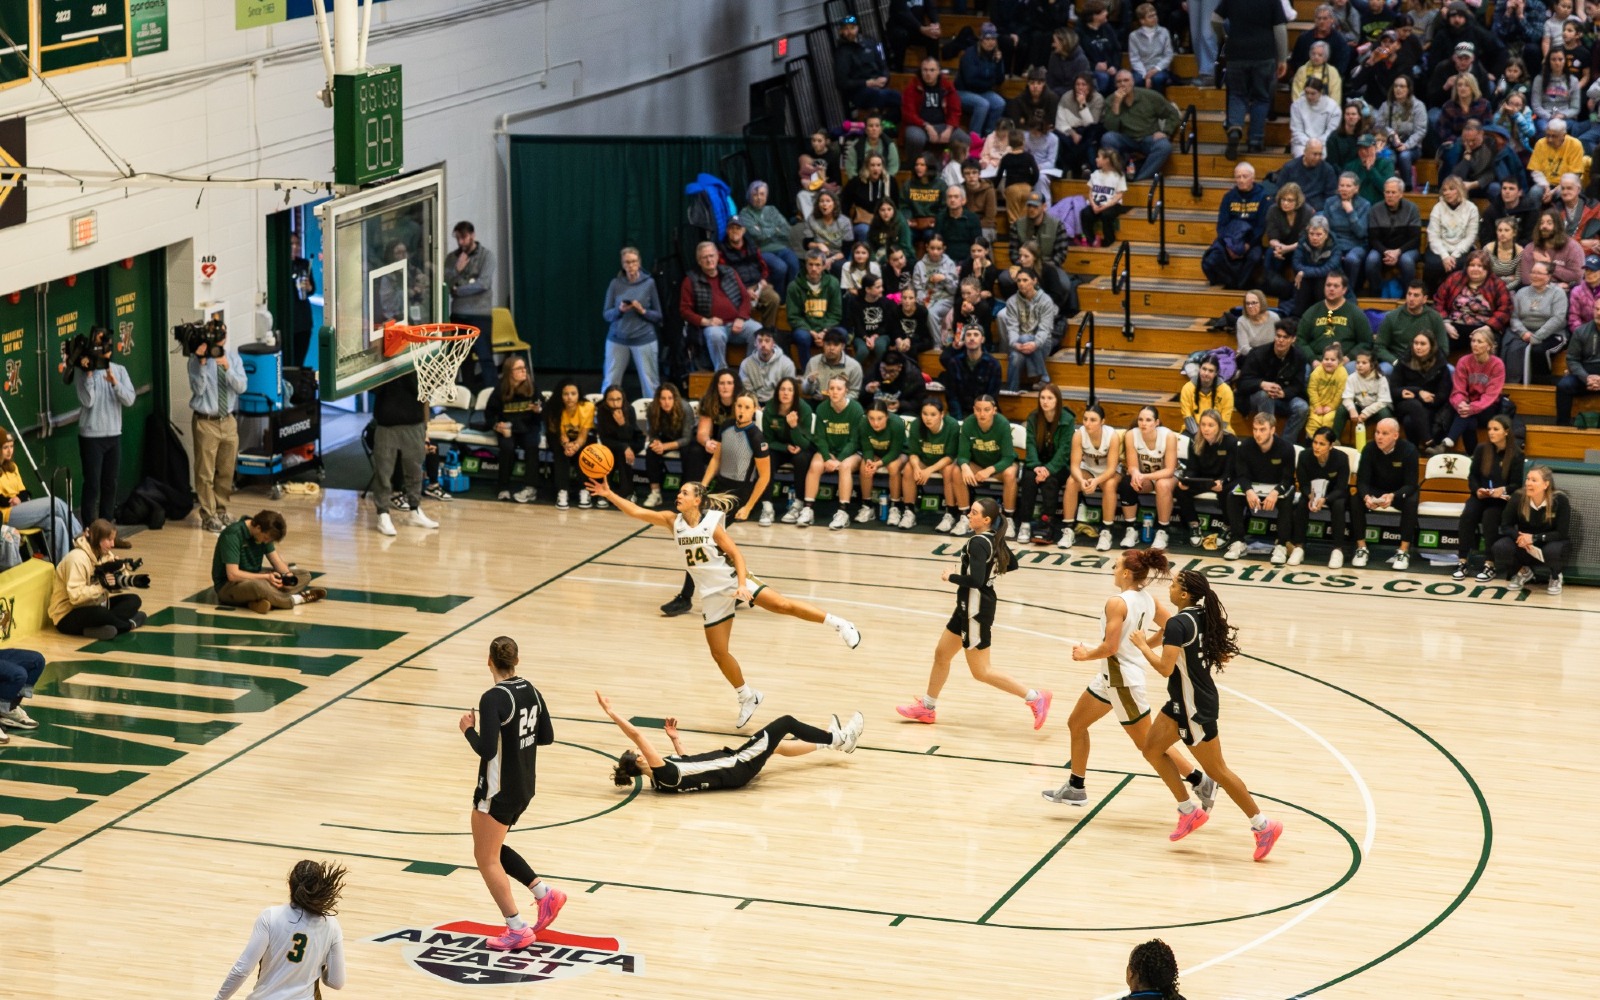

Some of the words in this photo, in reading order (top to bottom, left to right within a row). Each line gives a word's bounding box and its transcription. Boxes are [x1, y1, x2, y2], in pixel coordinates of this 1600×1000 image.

[1178, 223, 1186, 235] G
[201, 255, 217, 263] AED
[1144, 294, 1151, 306] E
[1108, 368, 1115, 380] C
[279, 418, 311, 438] POWERADE
[1250, 520, 1266, 531] TD
[678, 536, 709, 546] VERMONT
[1382, 531, 1402, 540] Ban
[1421, 533, 1437, 544] TD
[1441, 535, 1460, 544] Ban
[685, 547, 710, 567] 24
[519, 704, 538, 737] 24
[286, 931, 308, 964] 3
[416, 945, 575, 976] EAST
